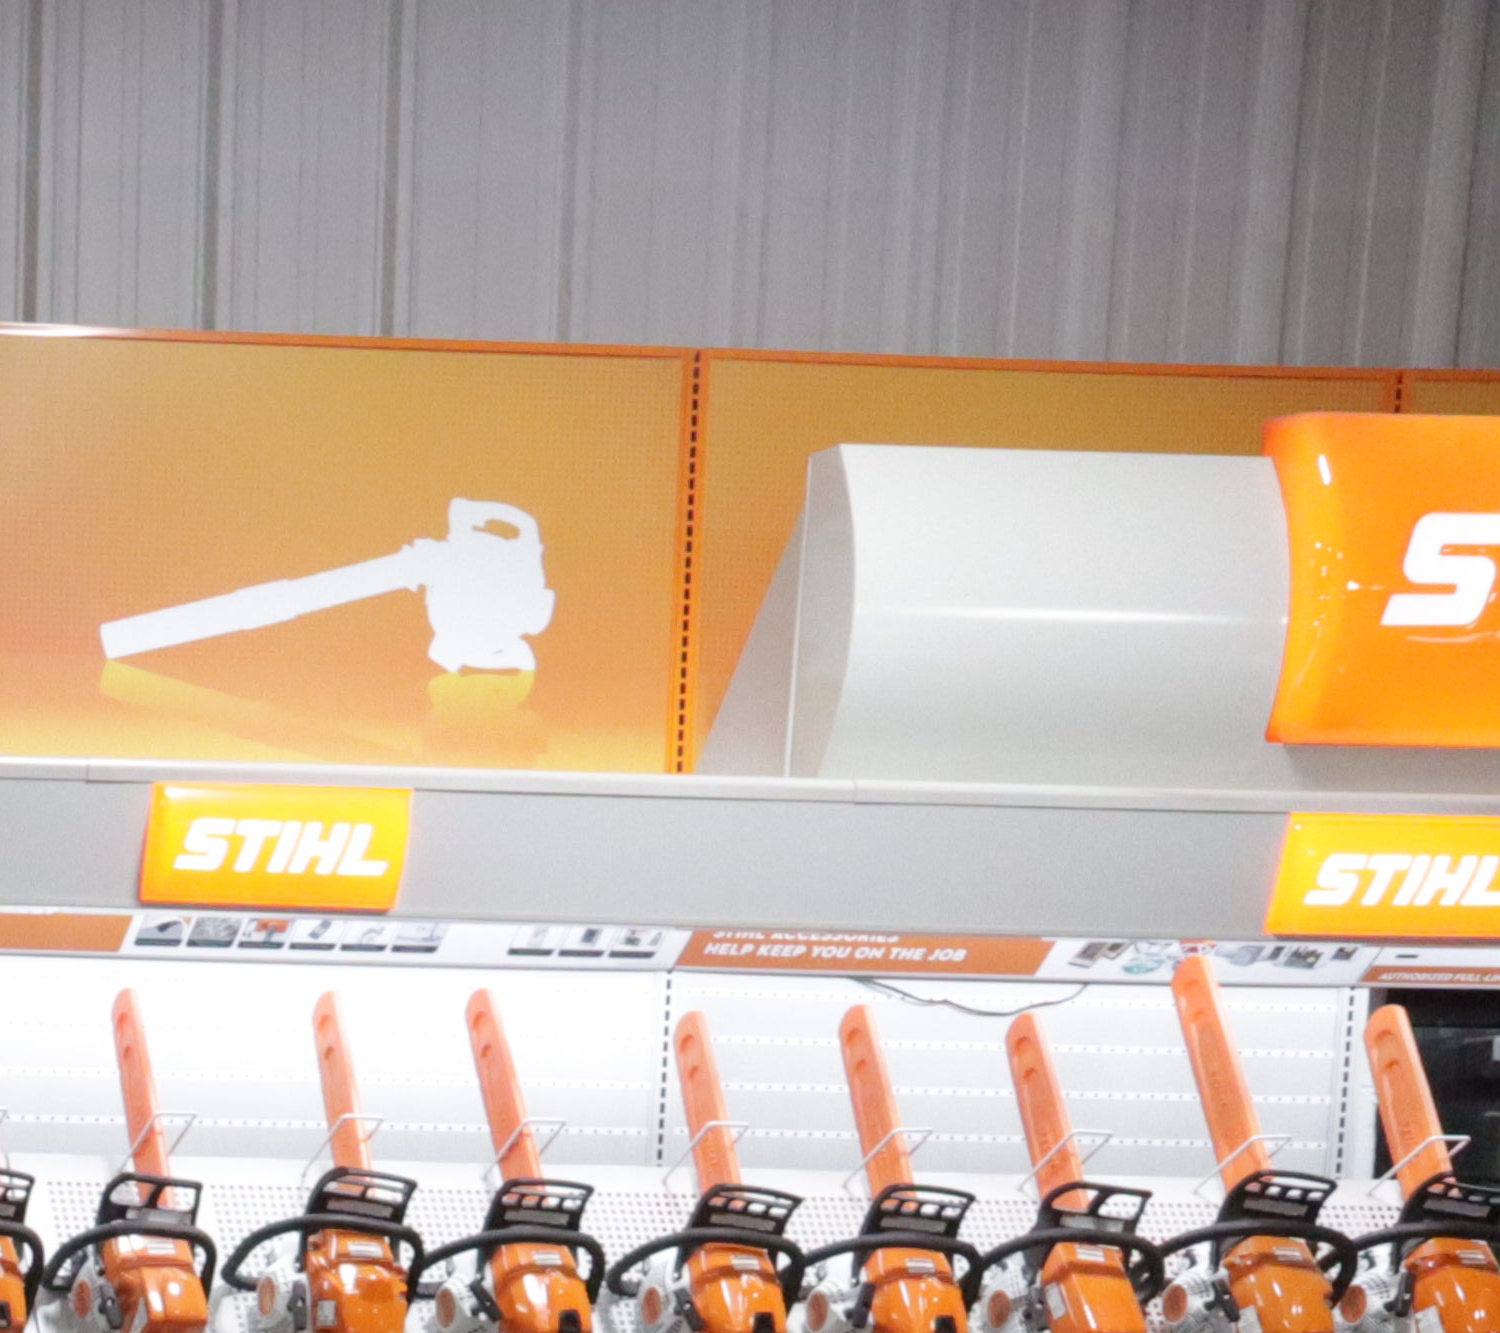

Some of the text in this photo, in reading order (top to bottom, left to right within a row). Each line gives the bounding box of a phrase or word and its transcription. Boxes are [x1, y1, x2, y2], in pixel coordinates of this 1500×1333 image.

[173, 817, 389, 877] STIHL
[1303, 853, 1500, 907] STIHL
[704, 943, 968, 962] HELP KEEP YOU ON THE JOB
